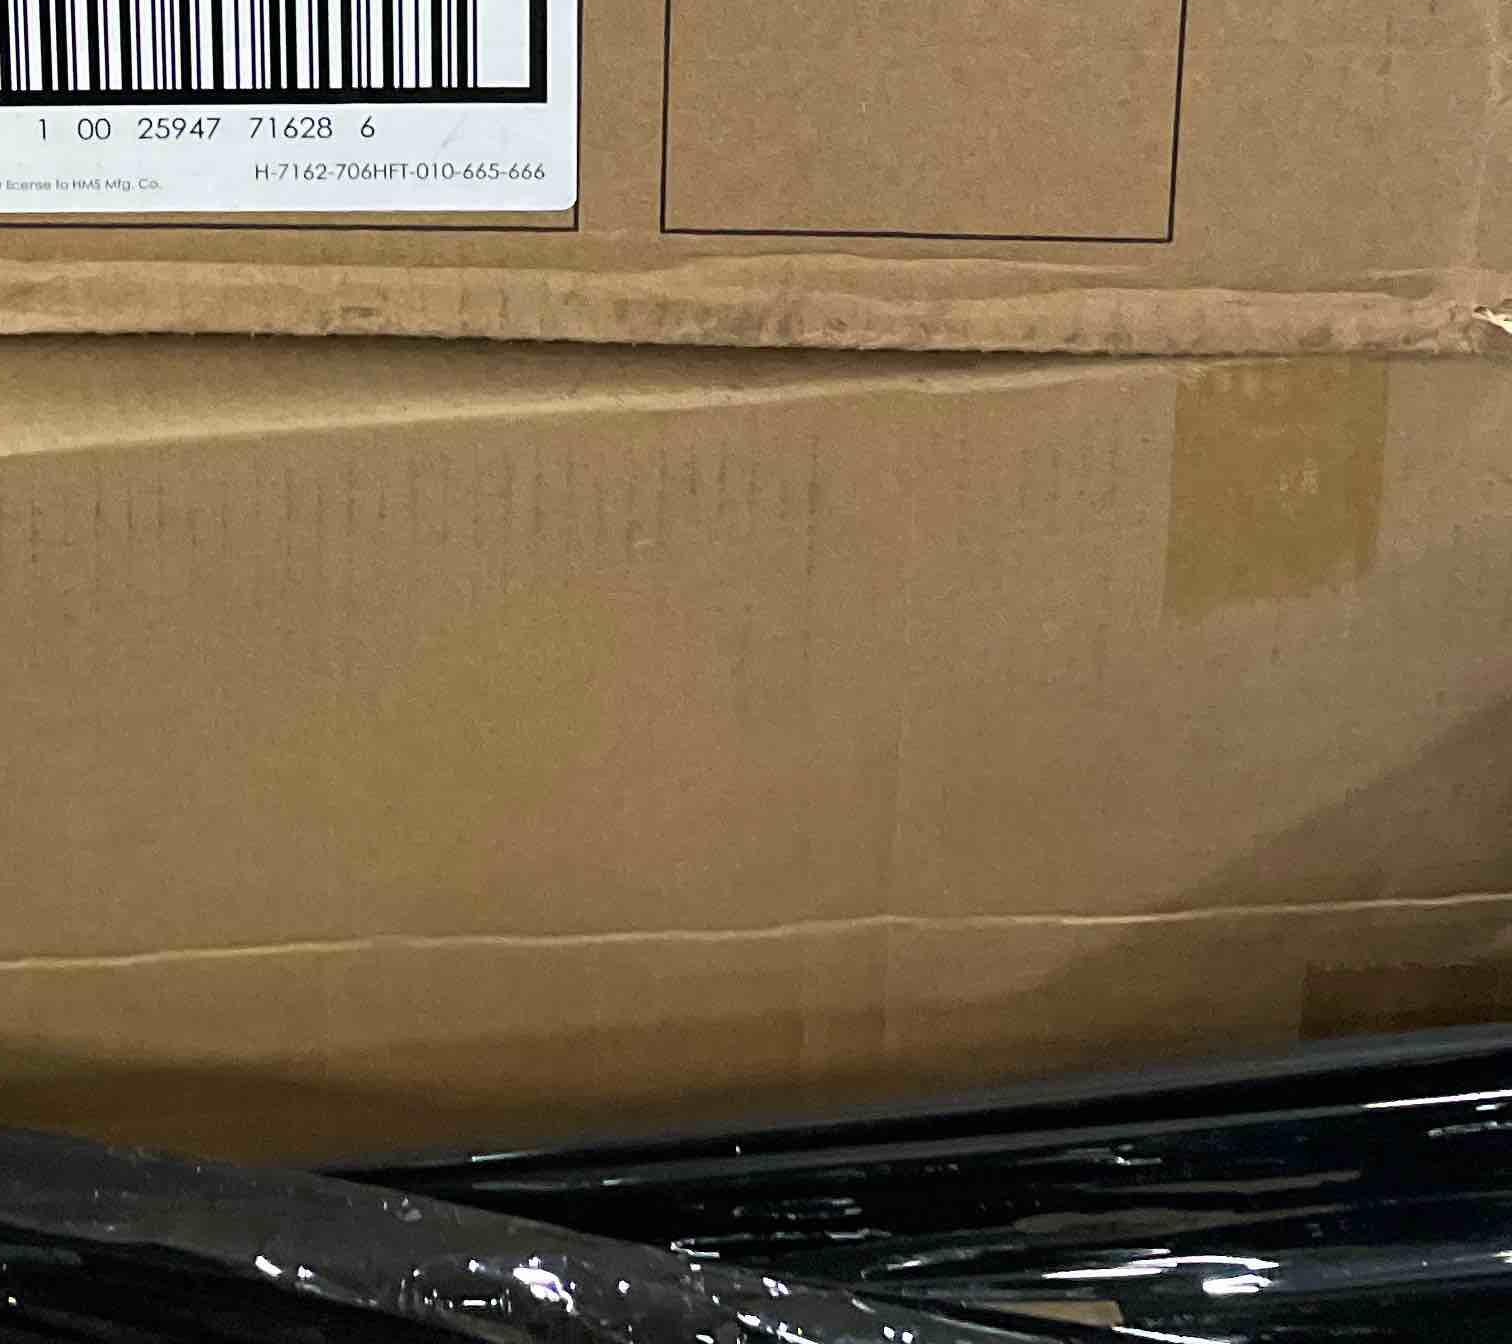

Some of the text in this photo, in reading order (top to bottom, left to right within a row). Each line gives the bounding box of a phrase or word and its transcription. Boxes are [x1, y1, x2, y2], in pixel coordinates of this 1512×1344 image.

[39, 116, 377, 141] 1 00 25947 71628 6
[255, 163, 546, 182] H-7162-706HFT-010-665-666
[73, 179, 101, 191] HMS
